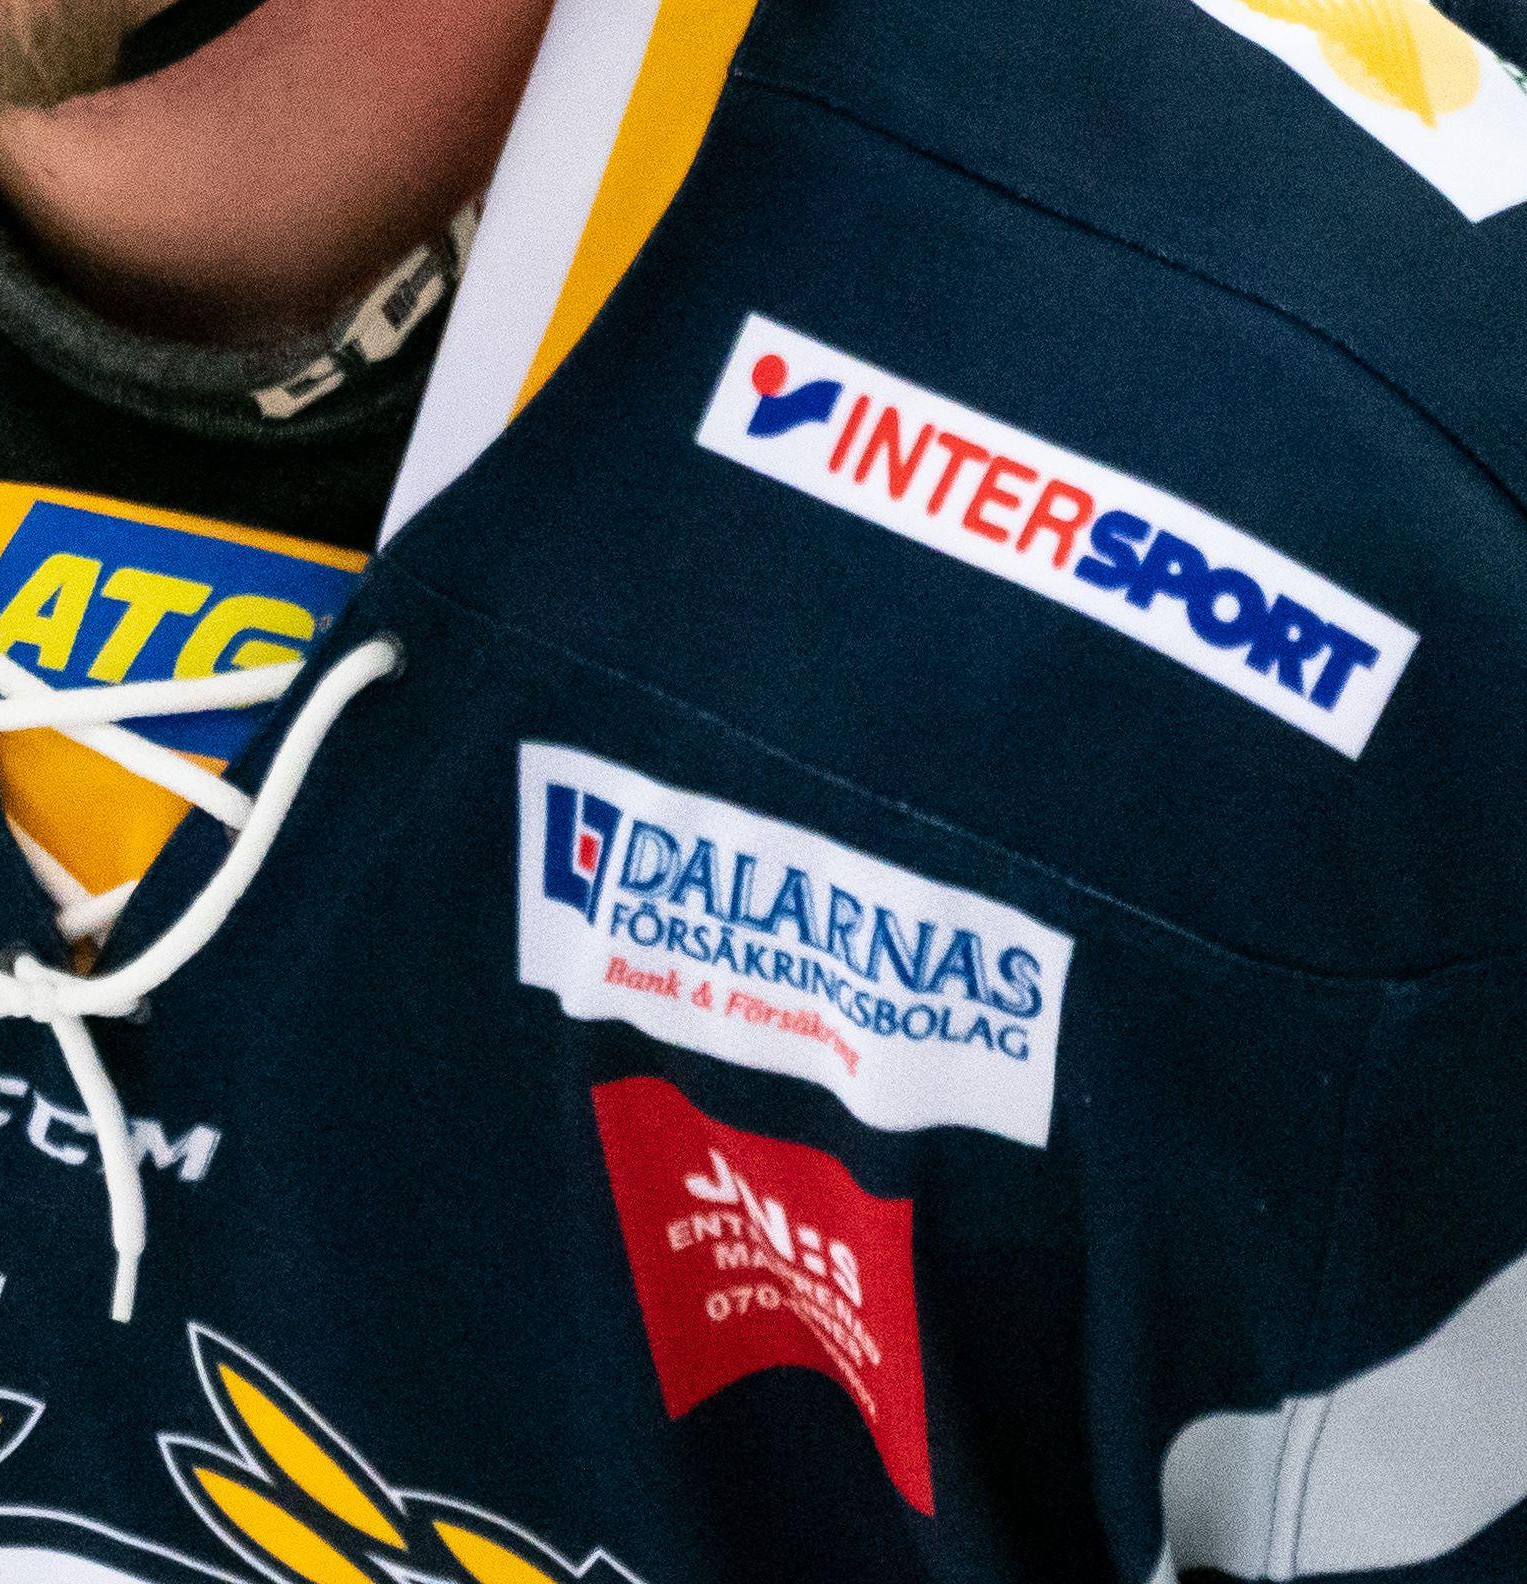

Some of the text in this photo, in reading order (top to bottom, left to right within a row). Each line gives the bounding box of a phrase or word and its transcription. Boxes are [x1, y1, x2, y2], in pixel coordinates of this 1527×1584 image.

[828, 393, 1381, 713] INTERSPORT
[603, 956, 681, 1000] Bank
[691, 981, 714, 1013] &
[609, 900, 1031, 1062] FÖRSÄKRINGSBOLAG
[618, 818, 1045, 1018] DALARNAS
